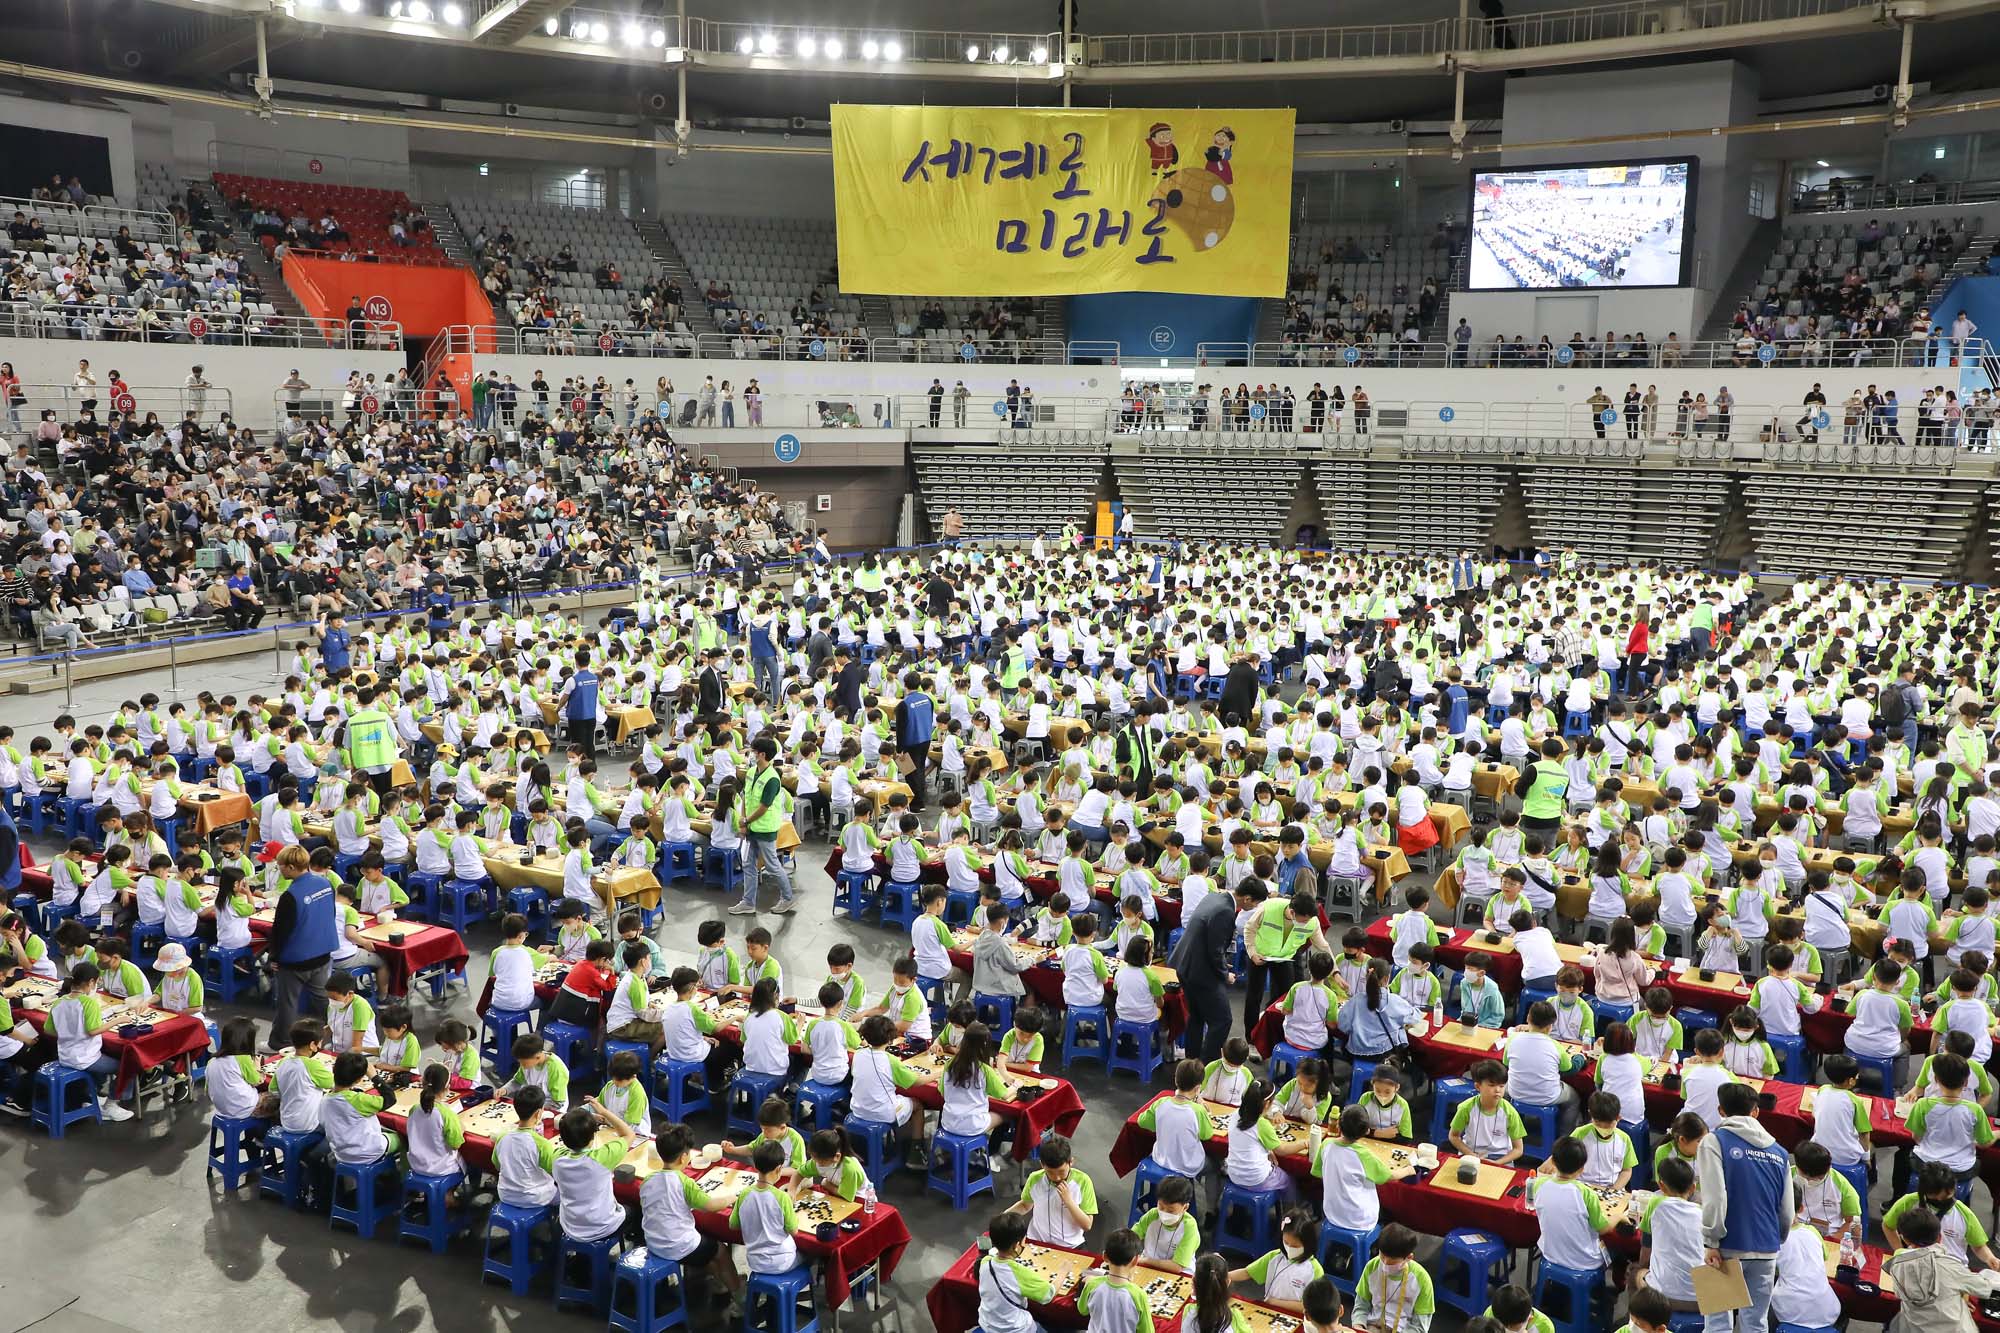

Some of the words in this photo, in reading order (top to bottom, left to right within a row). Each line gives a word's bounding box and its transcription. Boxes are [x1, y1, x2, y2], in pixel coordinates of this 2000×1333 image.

[901, 132, 1091, 200] 세계로
[996, 199, 1175, 264] 미래로
[370, 303, 388, 316] N3
[193, 323, 202, 331] 37
[1155, 332, 1170, 342] E2
[1762, 349, 1771, 357] 45
[121, 399, 132, 408] 09
[367, 400, 375, 408] 10
[780, 440, 794, 452] E1
